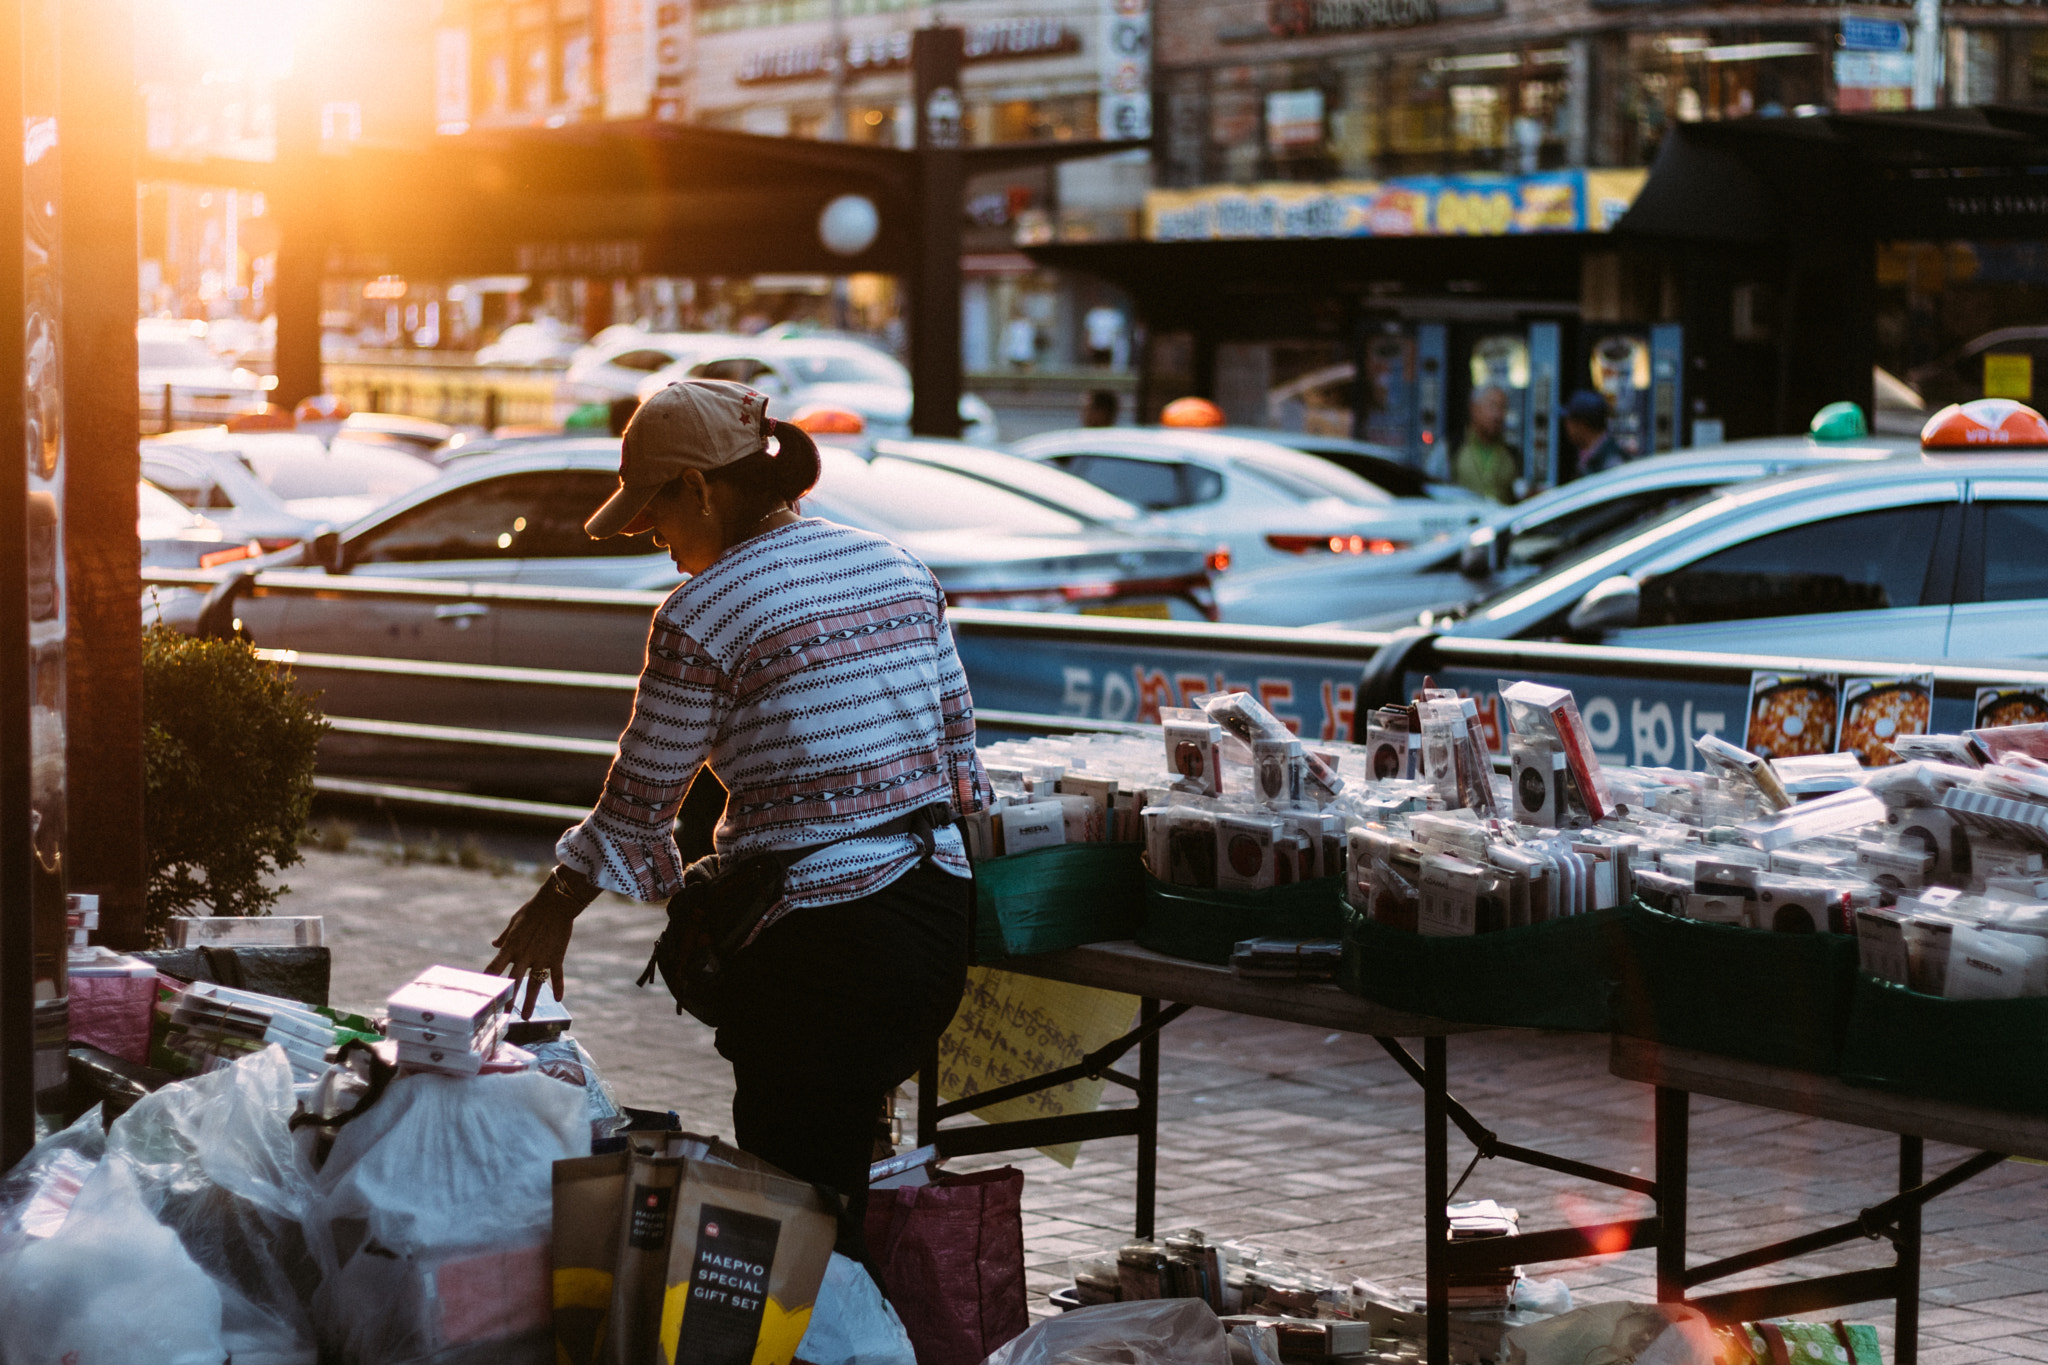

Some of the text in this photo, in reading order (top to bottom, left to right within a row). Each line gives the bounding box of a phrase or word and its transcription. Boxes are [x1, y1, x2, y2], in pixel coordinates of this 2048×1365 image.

[701, 1251, 764, 1276] HAEPYO
[698, 1269, 762, 1294] SPECIAL
[694, 1287, 760, 1311] GIFT SET
